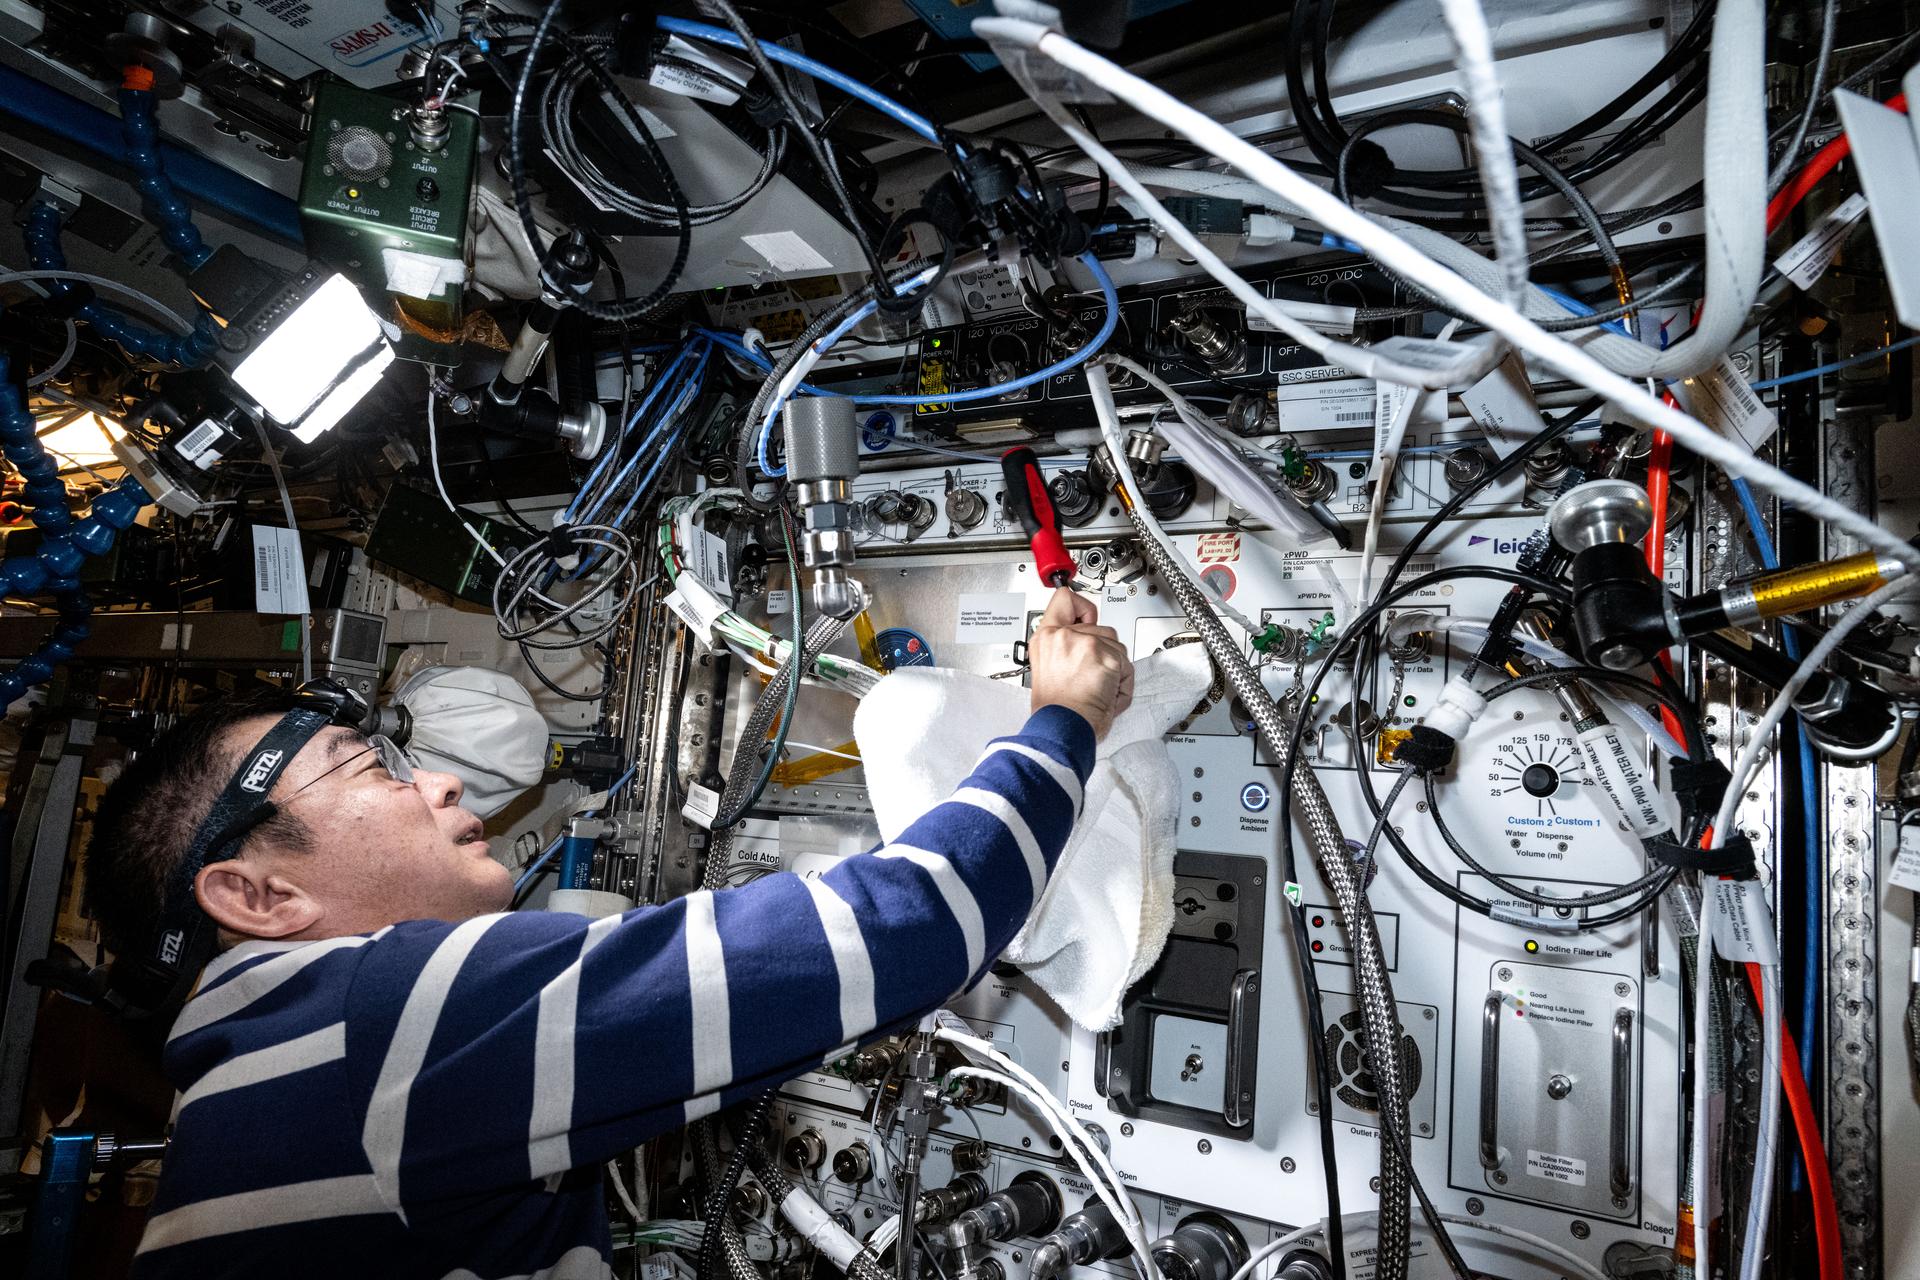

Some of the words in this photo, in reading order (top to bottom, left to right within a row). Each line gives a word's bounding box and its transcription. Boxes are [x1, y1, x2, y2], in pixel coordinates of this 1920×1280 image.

[278, 4, 312, 22] SYSTEM
[331, 22, 395, 56] SAMS-II
[412, 163, 438, 173] OUTPUT
[327, 200, 350, 211] POWER
[354, 205, 380, 216] OUTPUT
[410, 206, 440, 218] BREAKER
[412, 214, 438, 225] CIRCUIT
[411, 222, 436, 232] OUTPUT
[1307, 274, 1328, 286] 120
[1336, 268, 1363, 280] VDC
[1080, 310, 1098, 322] 120
[968, 328, 984, 339] 120
[990, 320, 1039, 336] VDC/1553
[1278, 345, 1300, 356] OFF
[1056, 374, 1076, 384] OFF
[1282, 372, 1302, 382] SSC
[1304, 368, 1346, 379] SERVER
[1352, 504, 1366, 512] B2
[1494, 536, 1532, 554] leid
[1284, 550, 1308, 558] xPWD
[1298, 592, 1317, 600] xPWD
[1512, 737, 1528, 745] 125
[1534, 734, 1550, 742] 150
[1556, 738, 1572, 746] 175
[1498, 744, 1514, 753] 100
[1605, 734, 1626, 756] INLET
[1571, 747, 1582, 755] 20
[1584, 742, 1600, 764] INLET
[1492, 758, 1503, 766] 75
[242, 750, 283, 792] PETZL
[1617, 756, 1639, 786] WATER
[1596, 765, 1613, 792] WATER
[1490, 789, 1501, 797] 25
[1631, 785, 1650, 805] PWD
[1240, 816, 1269, 826] Dispense
[1507, 816, 1545, 826] Custom
[1547, 819, 1553, 827] 2
[1555, 816, 1593, 826] Custom
[1505, 830, 1528, 838] Water
[1536, 832, 1574, 841] Dispense
[738, 850, 758, 861] Cold
[1515, 850, 1545, 859] Volume
[1547, 851, 1563, 860] (ml)
[1486, 898, 1510, 906] Iodine
[1513, 900, 1533, 909] Filter
[1732, 922, 1741, 942] Cable
[1546, 944, 1571, 954] Iodine
[1573, 947, 1594, 957] Filter
[1596, 950, 1612, 959] Life
[1530, 1002, 1554, 1011] Nearing
[1529, 1012, 1554, 1022] Replace
[1556, 1016, 1575, 1024] Iodine
[1070, 1099, 1092, 1111] Closed
[831, 1120, 847, 1129] SAMS
[1350, 1127, 1372, 1137] Outlet
[930, 1145, 952, 1155] LAPTO
[1540, 1154, 1557, 1163] Iodine
[1118, 1170, 1137, 1181] Open
[1060, 1177, 1093, 1191] COOLANT
[1069, 1188, 1084, 1196] WATER
[1643, 1222, 1674, 1235] Closed
